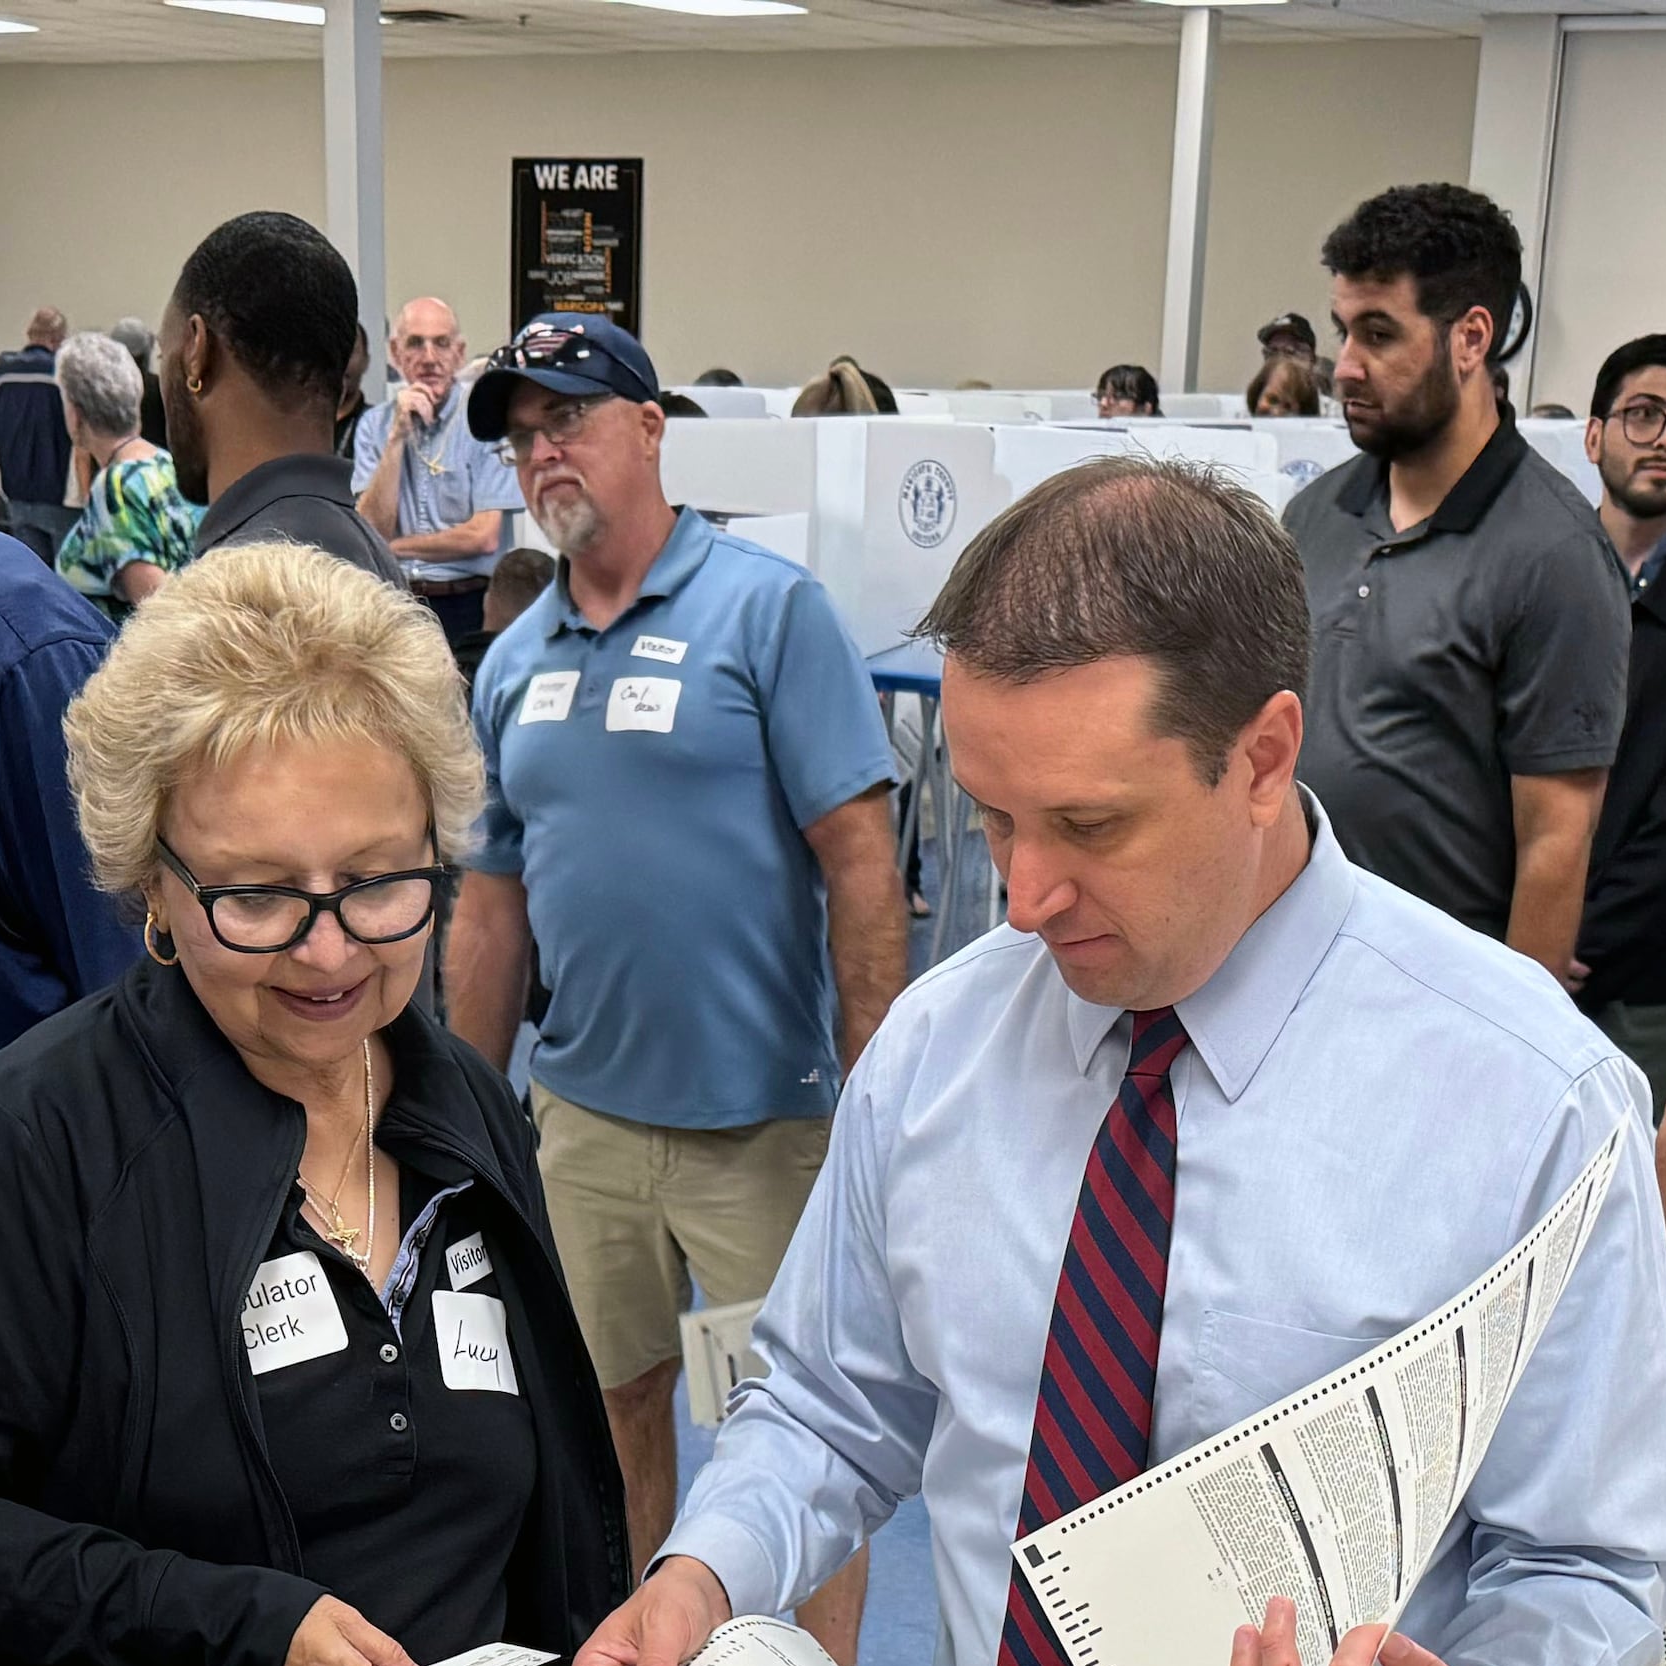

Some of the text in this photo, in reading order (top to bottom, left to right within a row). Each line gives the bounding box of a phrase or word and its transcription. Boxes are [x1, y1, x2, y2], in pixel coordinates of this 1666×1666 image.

[533, 164, 619, 190] WE ARE
[450, 1244, 487, 1275] Visitor
[244, 1314, 305, 1350] Clerk
[454, 1319, 501, 1387] Lucy
